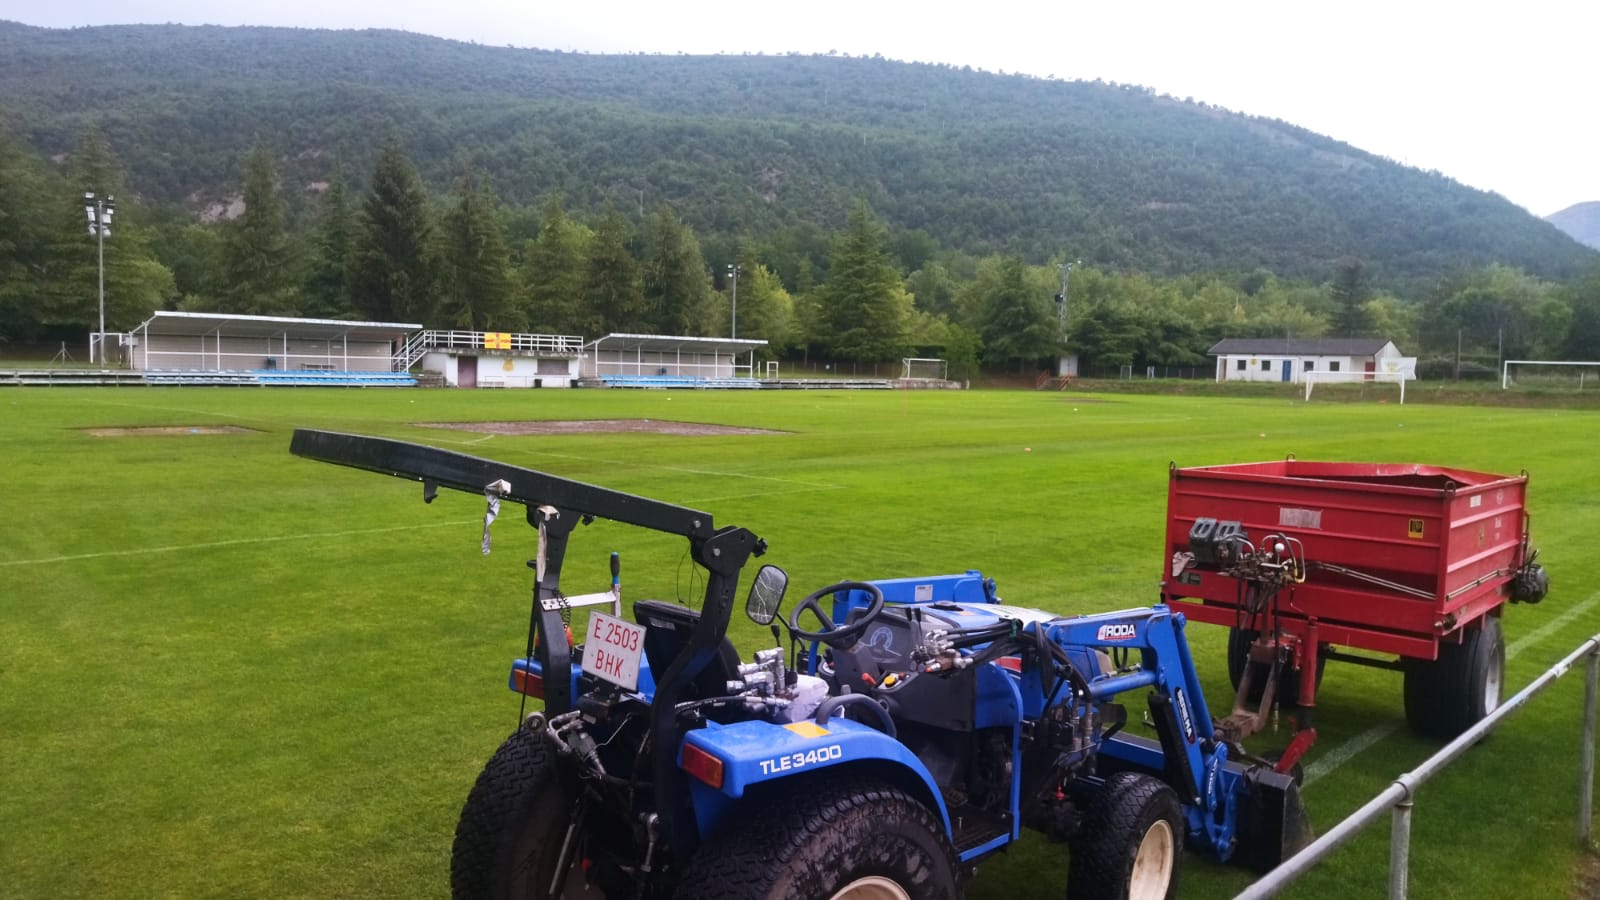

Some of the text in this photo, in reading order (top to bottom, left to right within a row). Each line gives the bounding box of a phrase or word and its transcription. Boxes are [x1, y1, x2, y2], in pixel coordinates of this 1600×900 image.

[594, 618, 639, 651] E 2503
[1106, 624, 1135, 637] RODA
[595, 649, 624, 679] BHK
[759, 744, 842, 775] TLE3400
